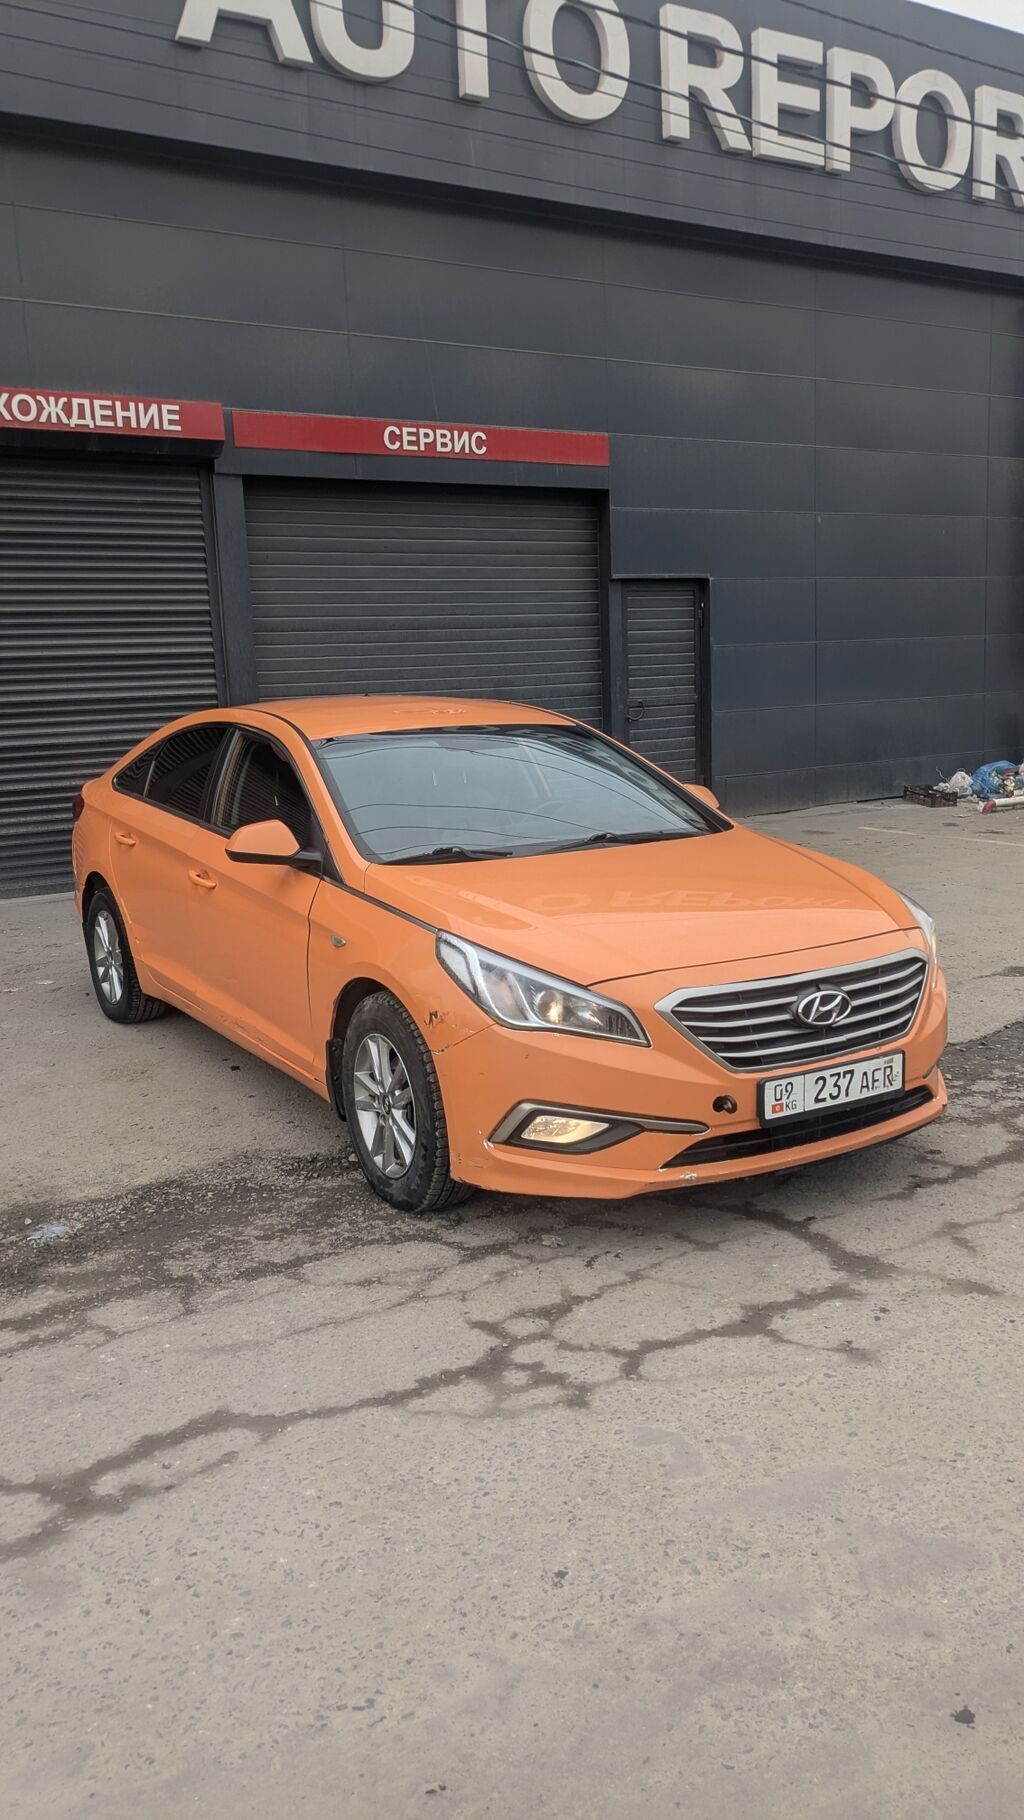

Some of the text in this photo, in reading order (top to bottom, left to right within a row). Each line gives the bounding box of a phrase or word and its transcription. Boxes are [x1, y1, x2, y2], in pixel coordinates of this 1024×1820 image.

[659, 3, 1024, 208] REPOR
[384, 425, 487, 455] СЕРВИС
[774, 1082, 794, 1102] 09
[814, 1069, 855, 1104] 237
[785, 1100, 797, 1111] KG
